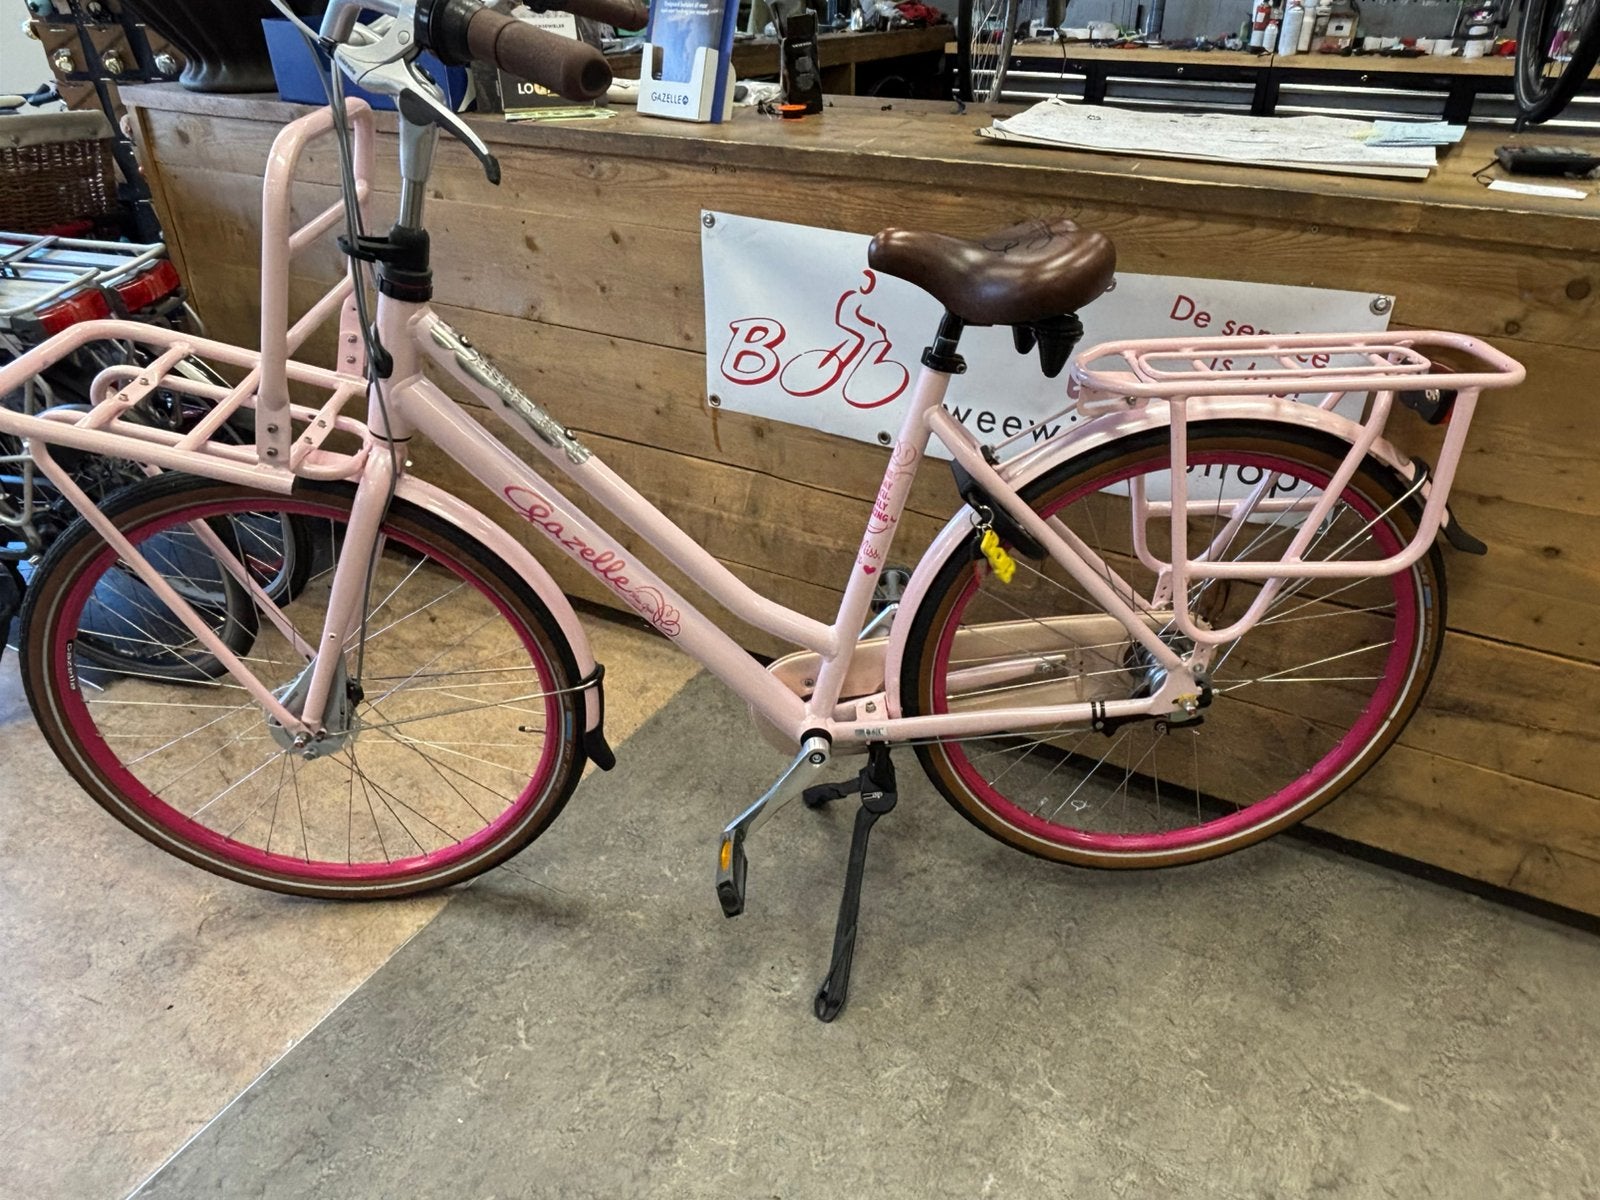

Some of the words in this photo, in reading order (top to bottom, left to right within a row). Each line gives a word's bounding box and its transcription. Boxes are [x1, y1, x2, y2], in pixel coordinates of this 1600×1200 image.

[651, 91, 682, 104] GAZELLE
[1169, 295, 1211, 328] De
[504, 486, 633, 592] Gazelle
[66, 643, 76, 691] Gazelle
